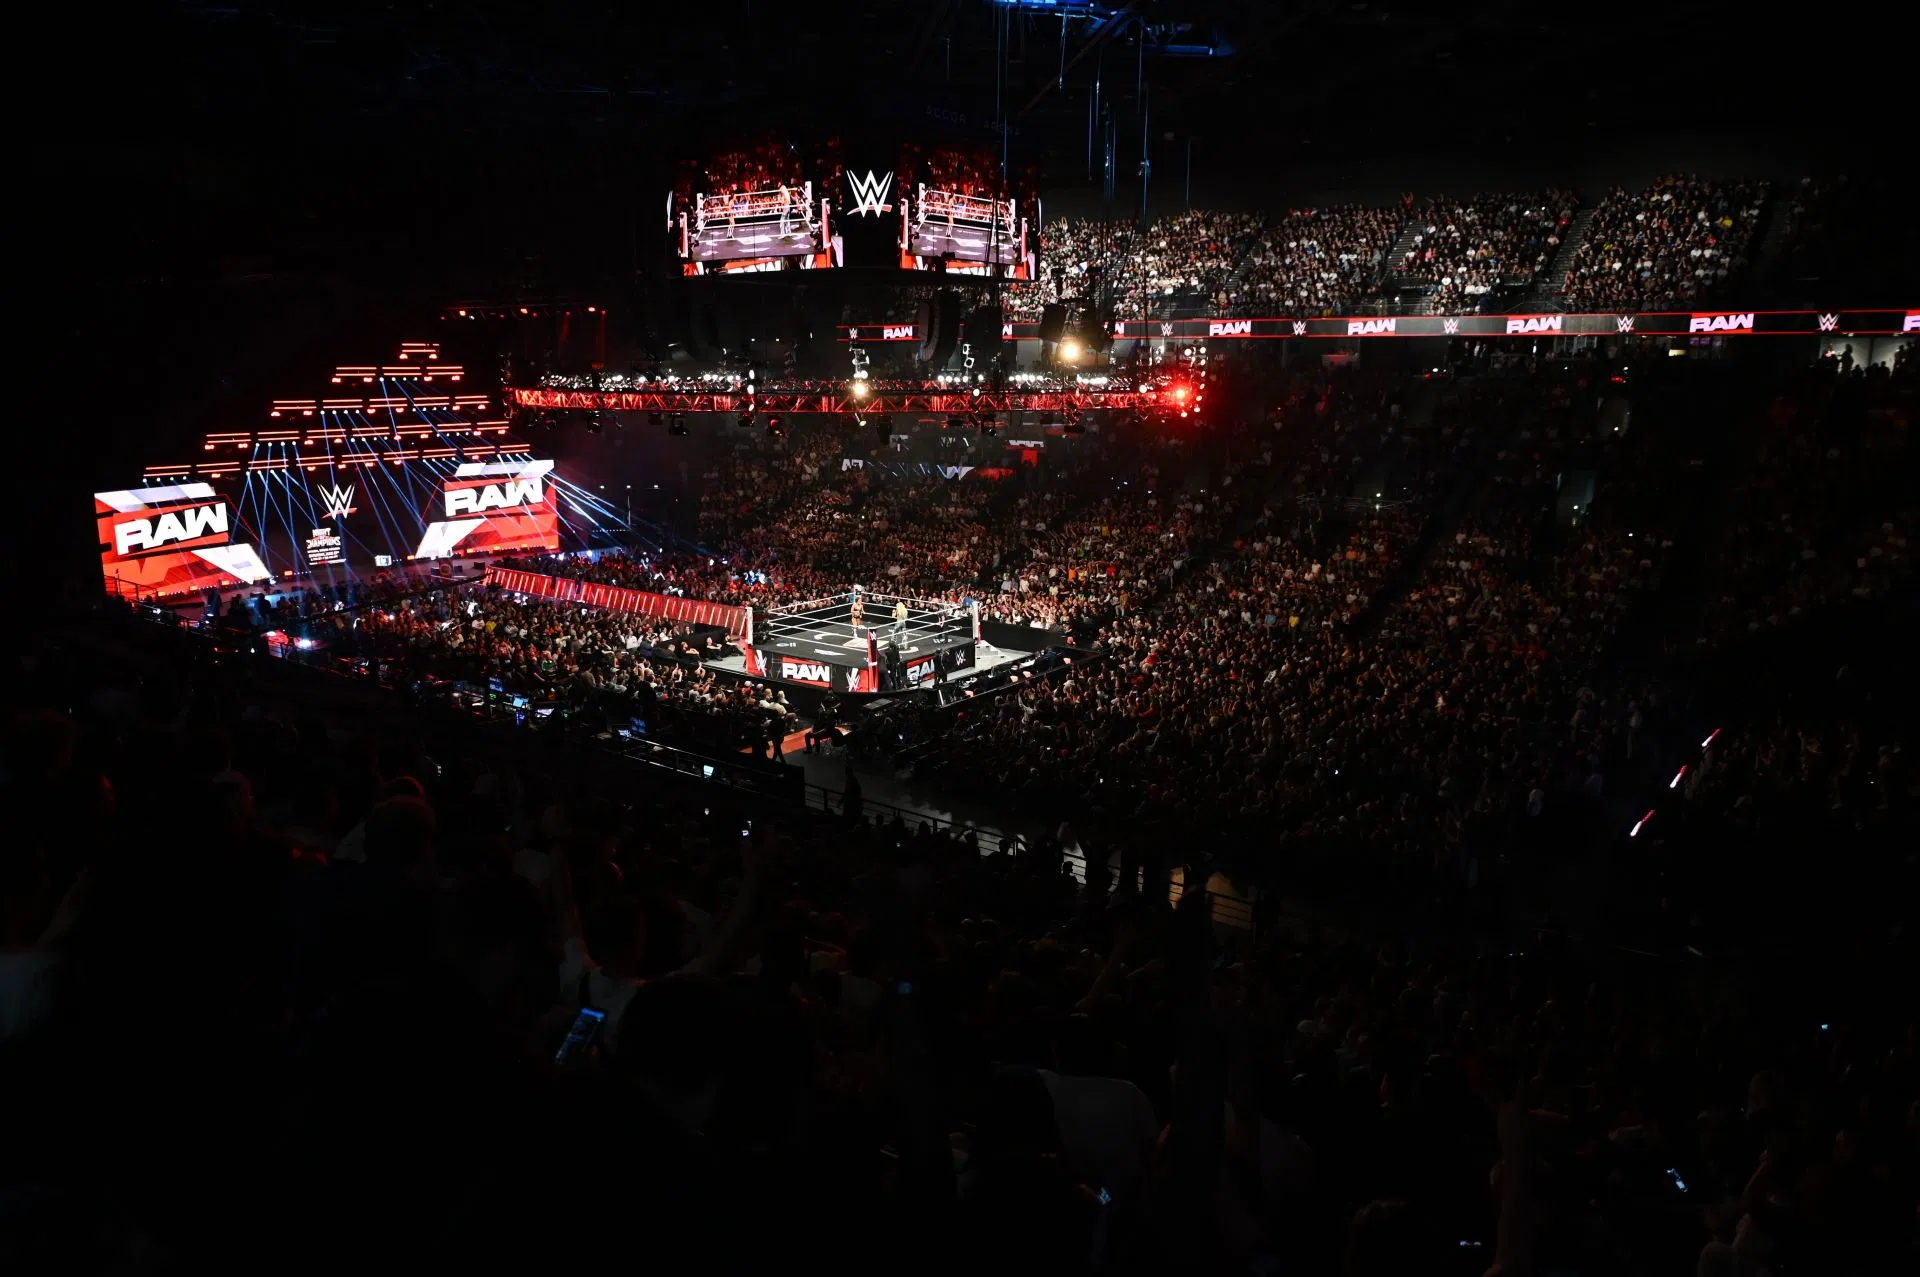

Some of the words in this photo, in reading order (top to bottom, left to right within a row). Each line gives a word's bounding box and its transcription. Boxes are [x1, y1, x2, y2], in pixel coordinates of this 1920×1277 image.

[1209, 321, 1251, 337] RAW
[1347, 318, 1396, 336] RAW
[1506, 316, 1562, 334] RAW
[1689, 313, 1754, 332] RAW
[883, 325, 912, 340] RAW
[444, 476, 543, 517] RAW
[114, 502, 229, 556] RAW
[782, 662, 831, 682] RAW
